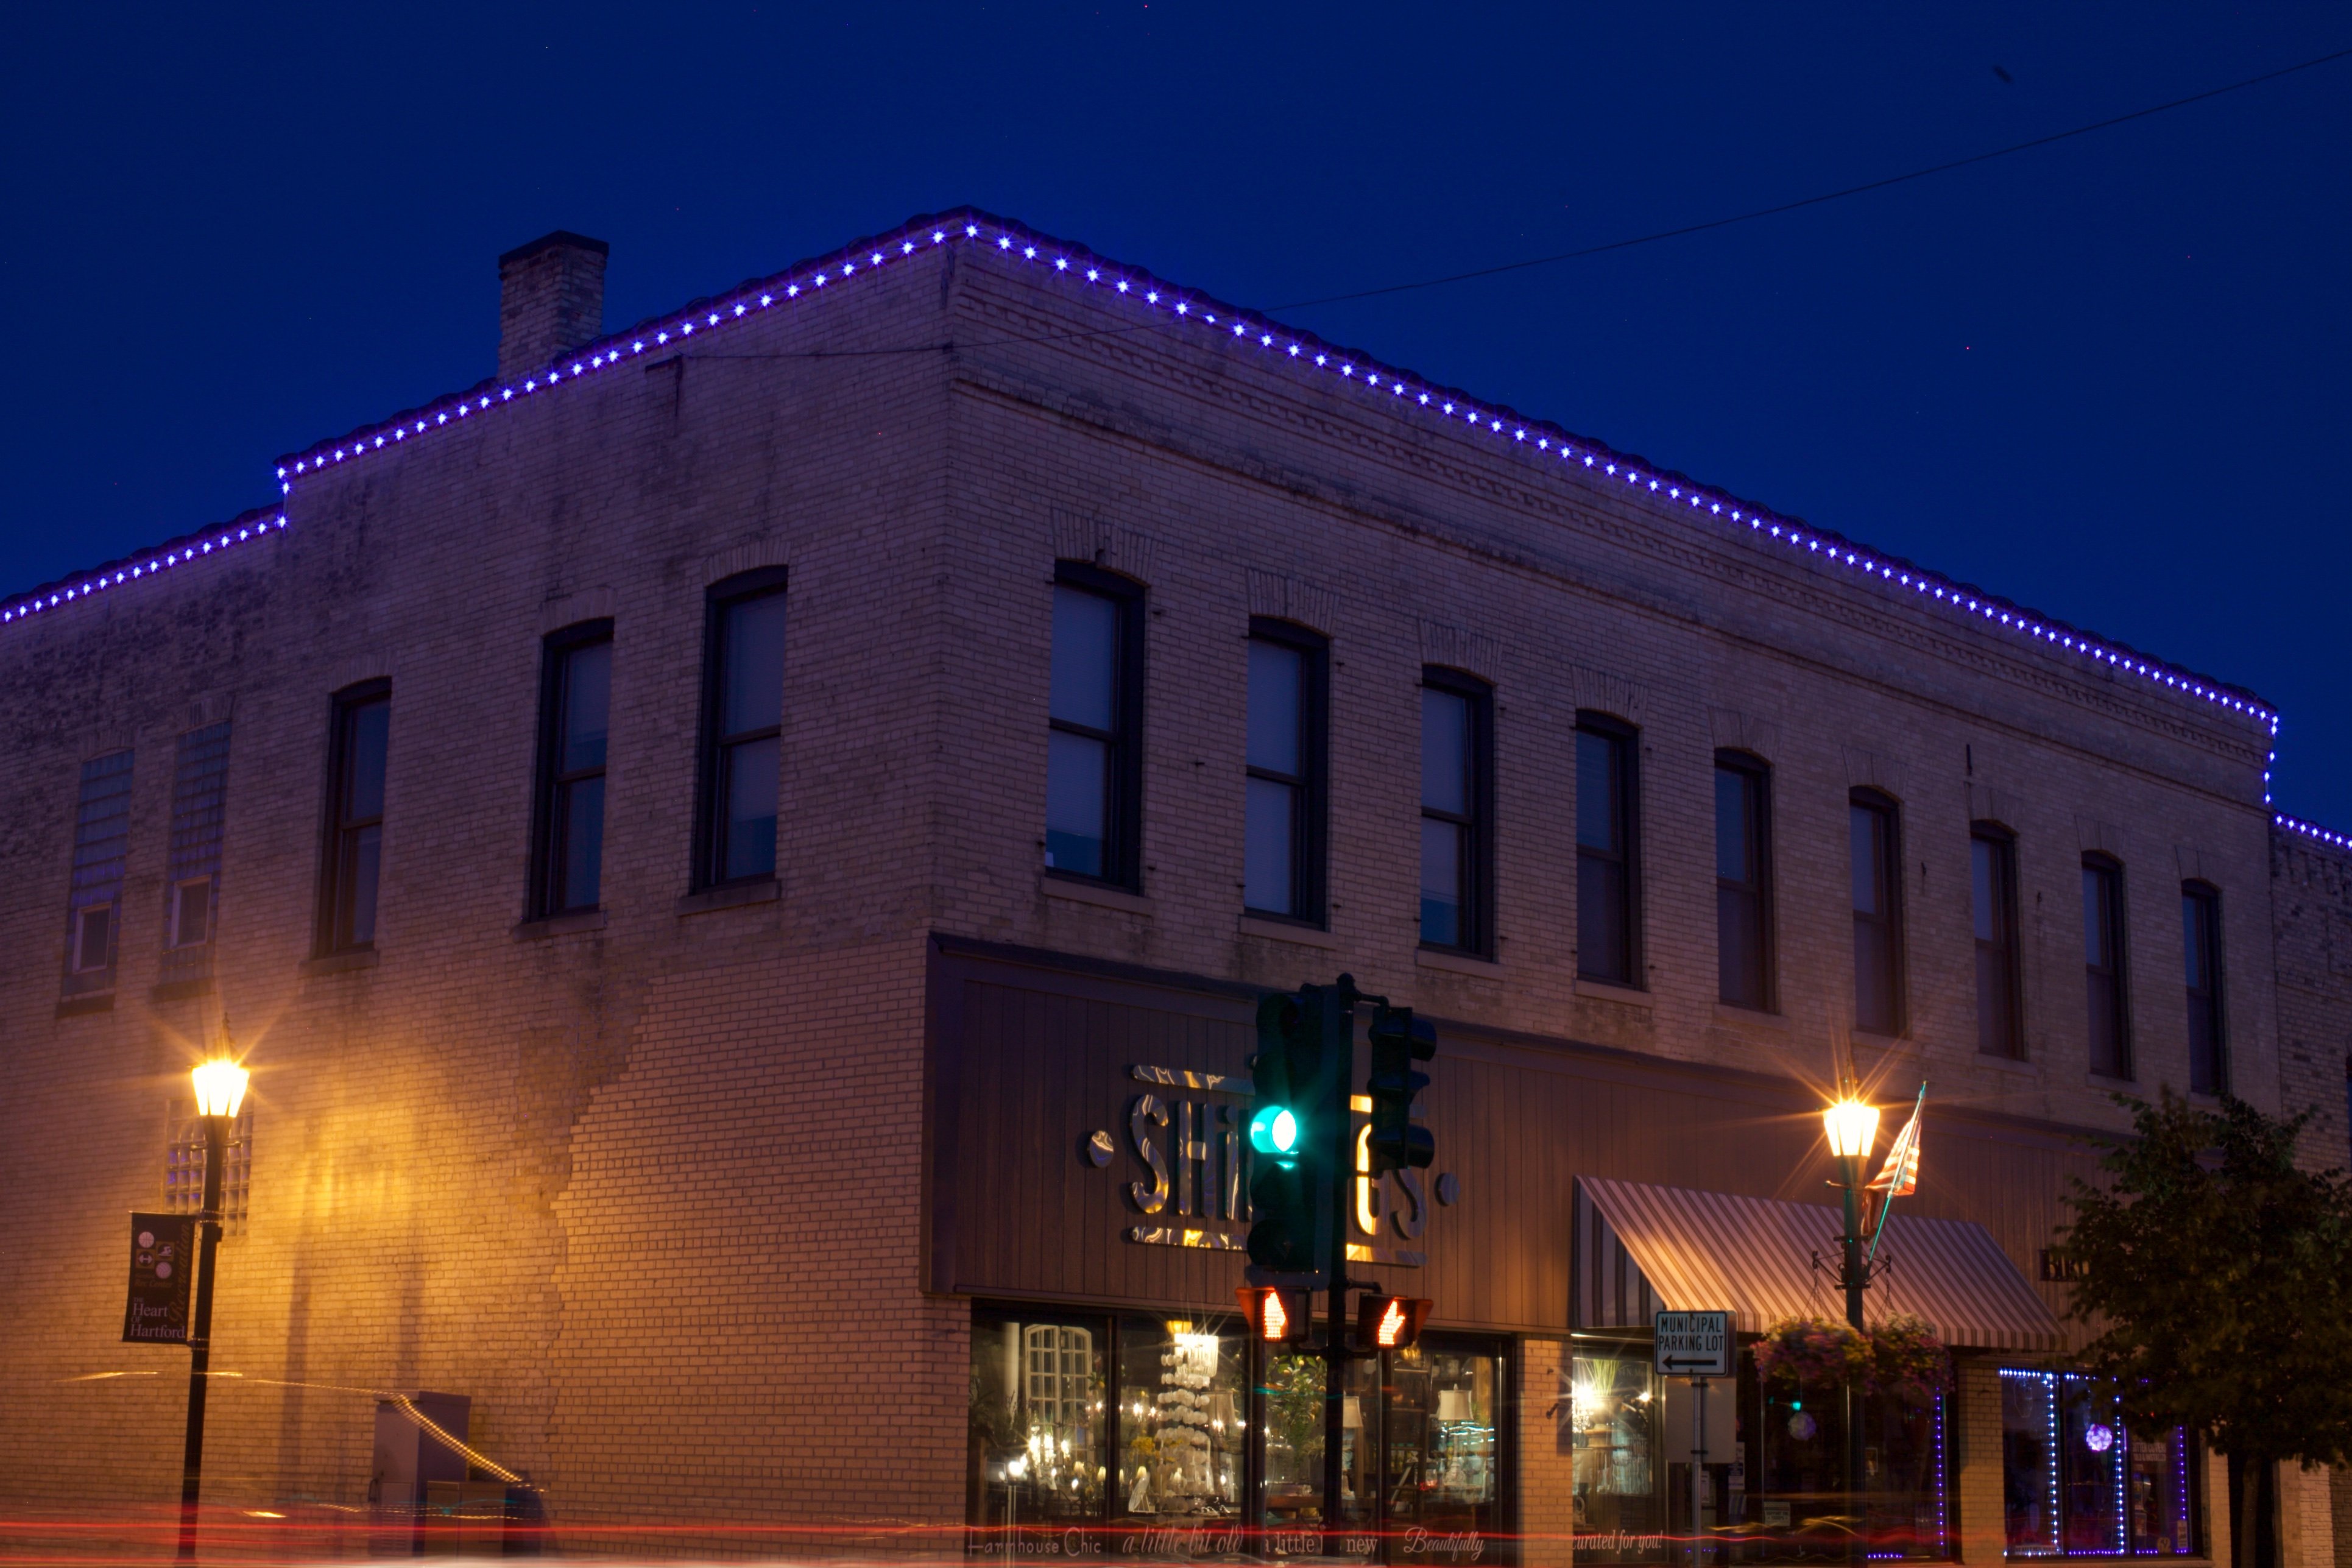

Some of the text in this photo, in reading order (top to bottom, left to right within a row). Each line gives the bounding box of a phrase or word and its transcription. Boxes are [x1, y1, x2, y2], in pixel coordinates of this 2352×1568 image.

[133, 1303, 168, 1317] Heart
[1661, 1316, 1722, 1333] MUNICIPAL
[1658, 1335, 1723, 1351] PARKING LOT
[968, 1527, 1101, 1557] Farmhouse Chic
[1123, 1524, 1244, 1553] a little bit old
[1276, 1532, 1315, 1553] little
[1346, 1538, 1377, 1553] new
[1403, 1527, 1486, 1562] Beautifully
[1572, 1529, 1663, 1555] curated for you!
